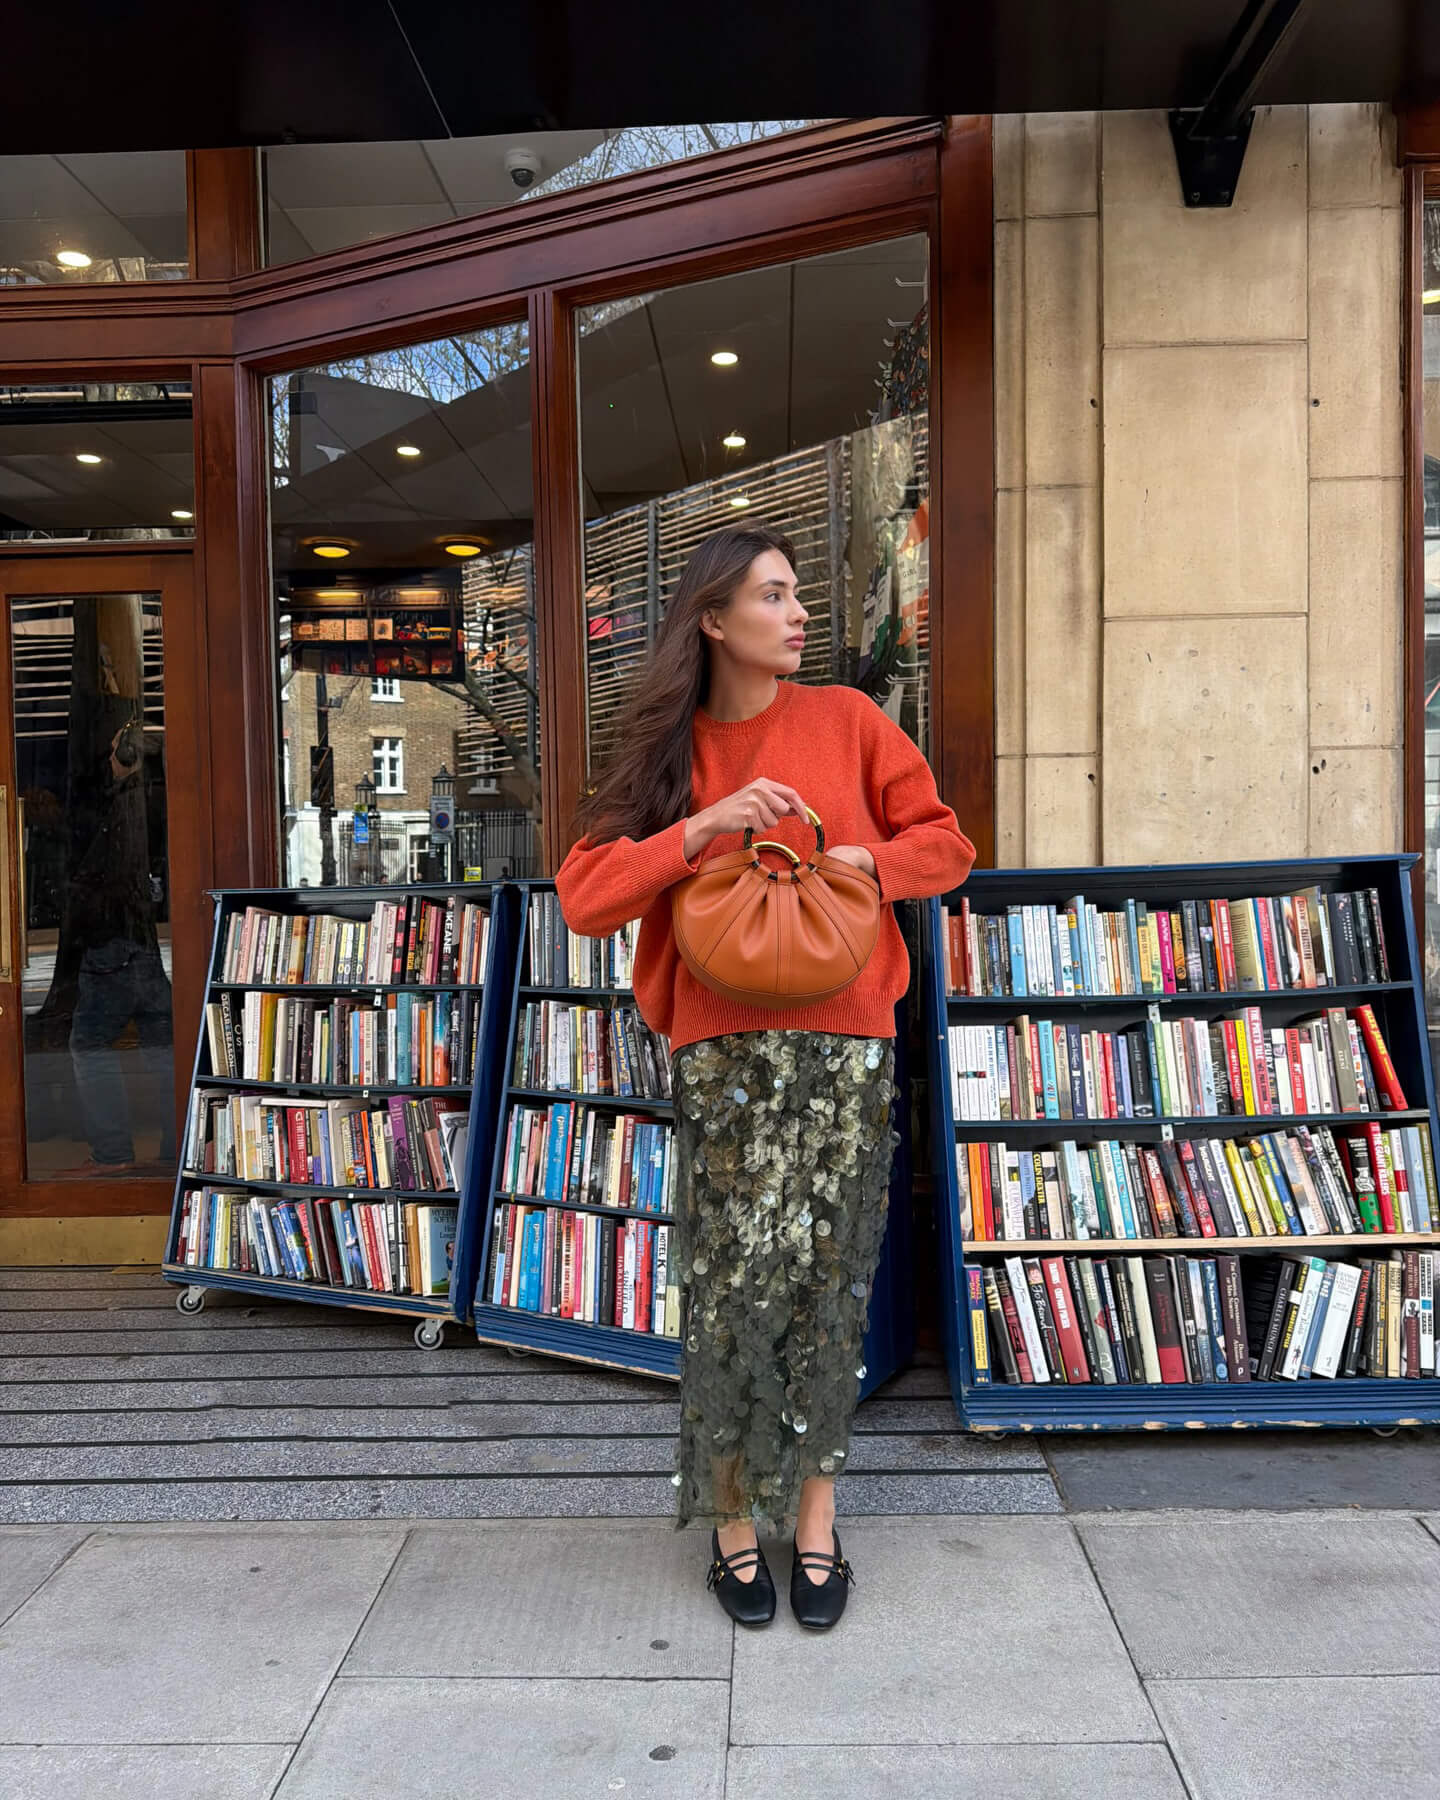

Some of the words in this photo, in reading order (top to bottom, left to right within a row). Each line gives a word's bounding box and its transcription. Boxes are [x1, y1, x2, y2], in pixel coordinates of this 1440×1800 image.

[221, 993, 231, 1024] OSCAR
[626, 1033, 638, 1067] CLOSE-UP
[1264, 1043, 1273, 1069] FURY
[1033, 1154, 1043, 1175] COLIN
[1199, 1146, 1215, 1182] INSURGENT
[1375, 1145, 1386, 1168] GIANT
[1036, 1177, 1046, 1204] DEXTER
[1378, 1169, 1390, 1195] KILLERS
[658, 1259, 667, 1268] K
[1361, 1270, 1370, 1289] PAUL
[1273, 1287, 1287, 1322] CHARLES
[1356, 1291, 1367, 1326] NEWMAN
[1266, 1323, 1280, 1353] MUNCH
